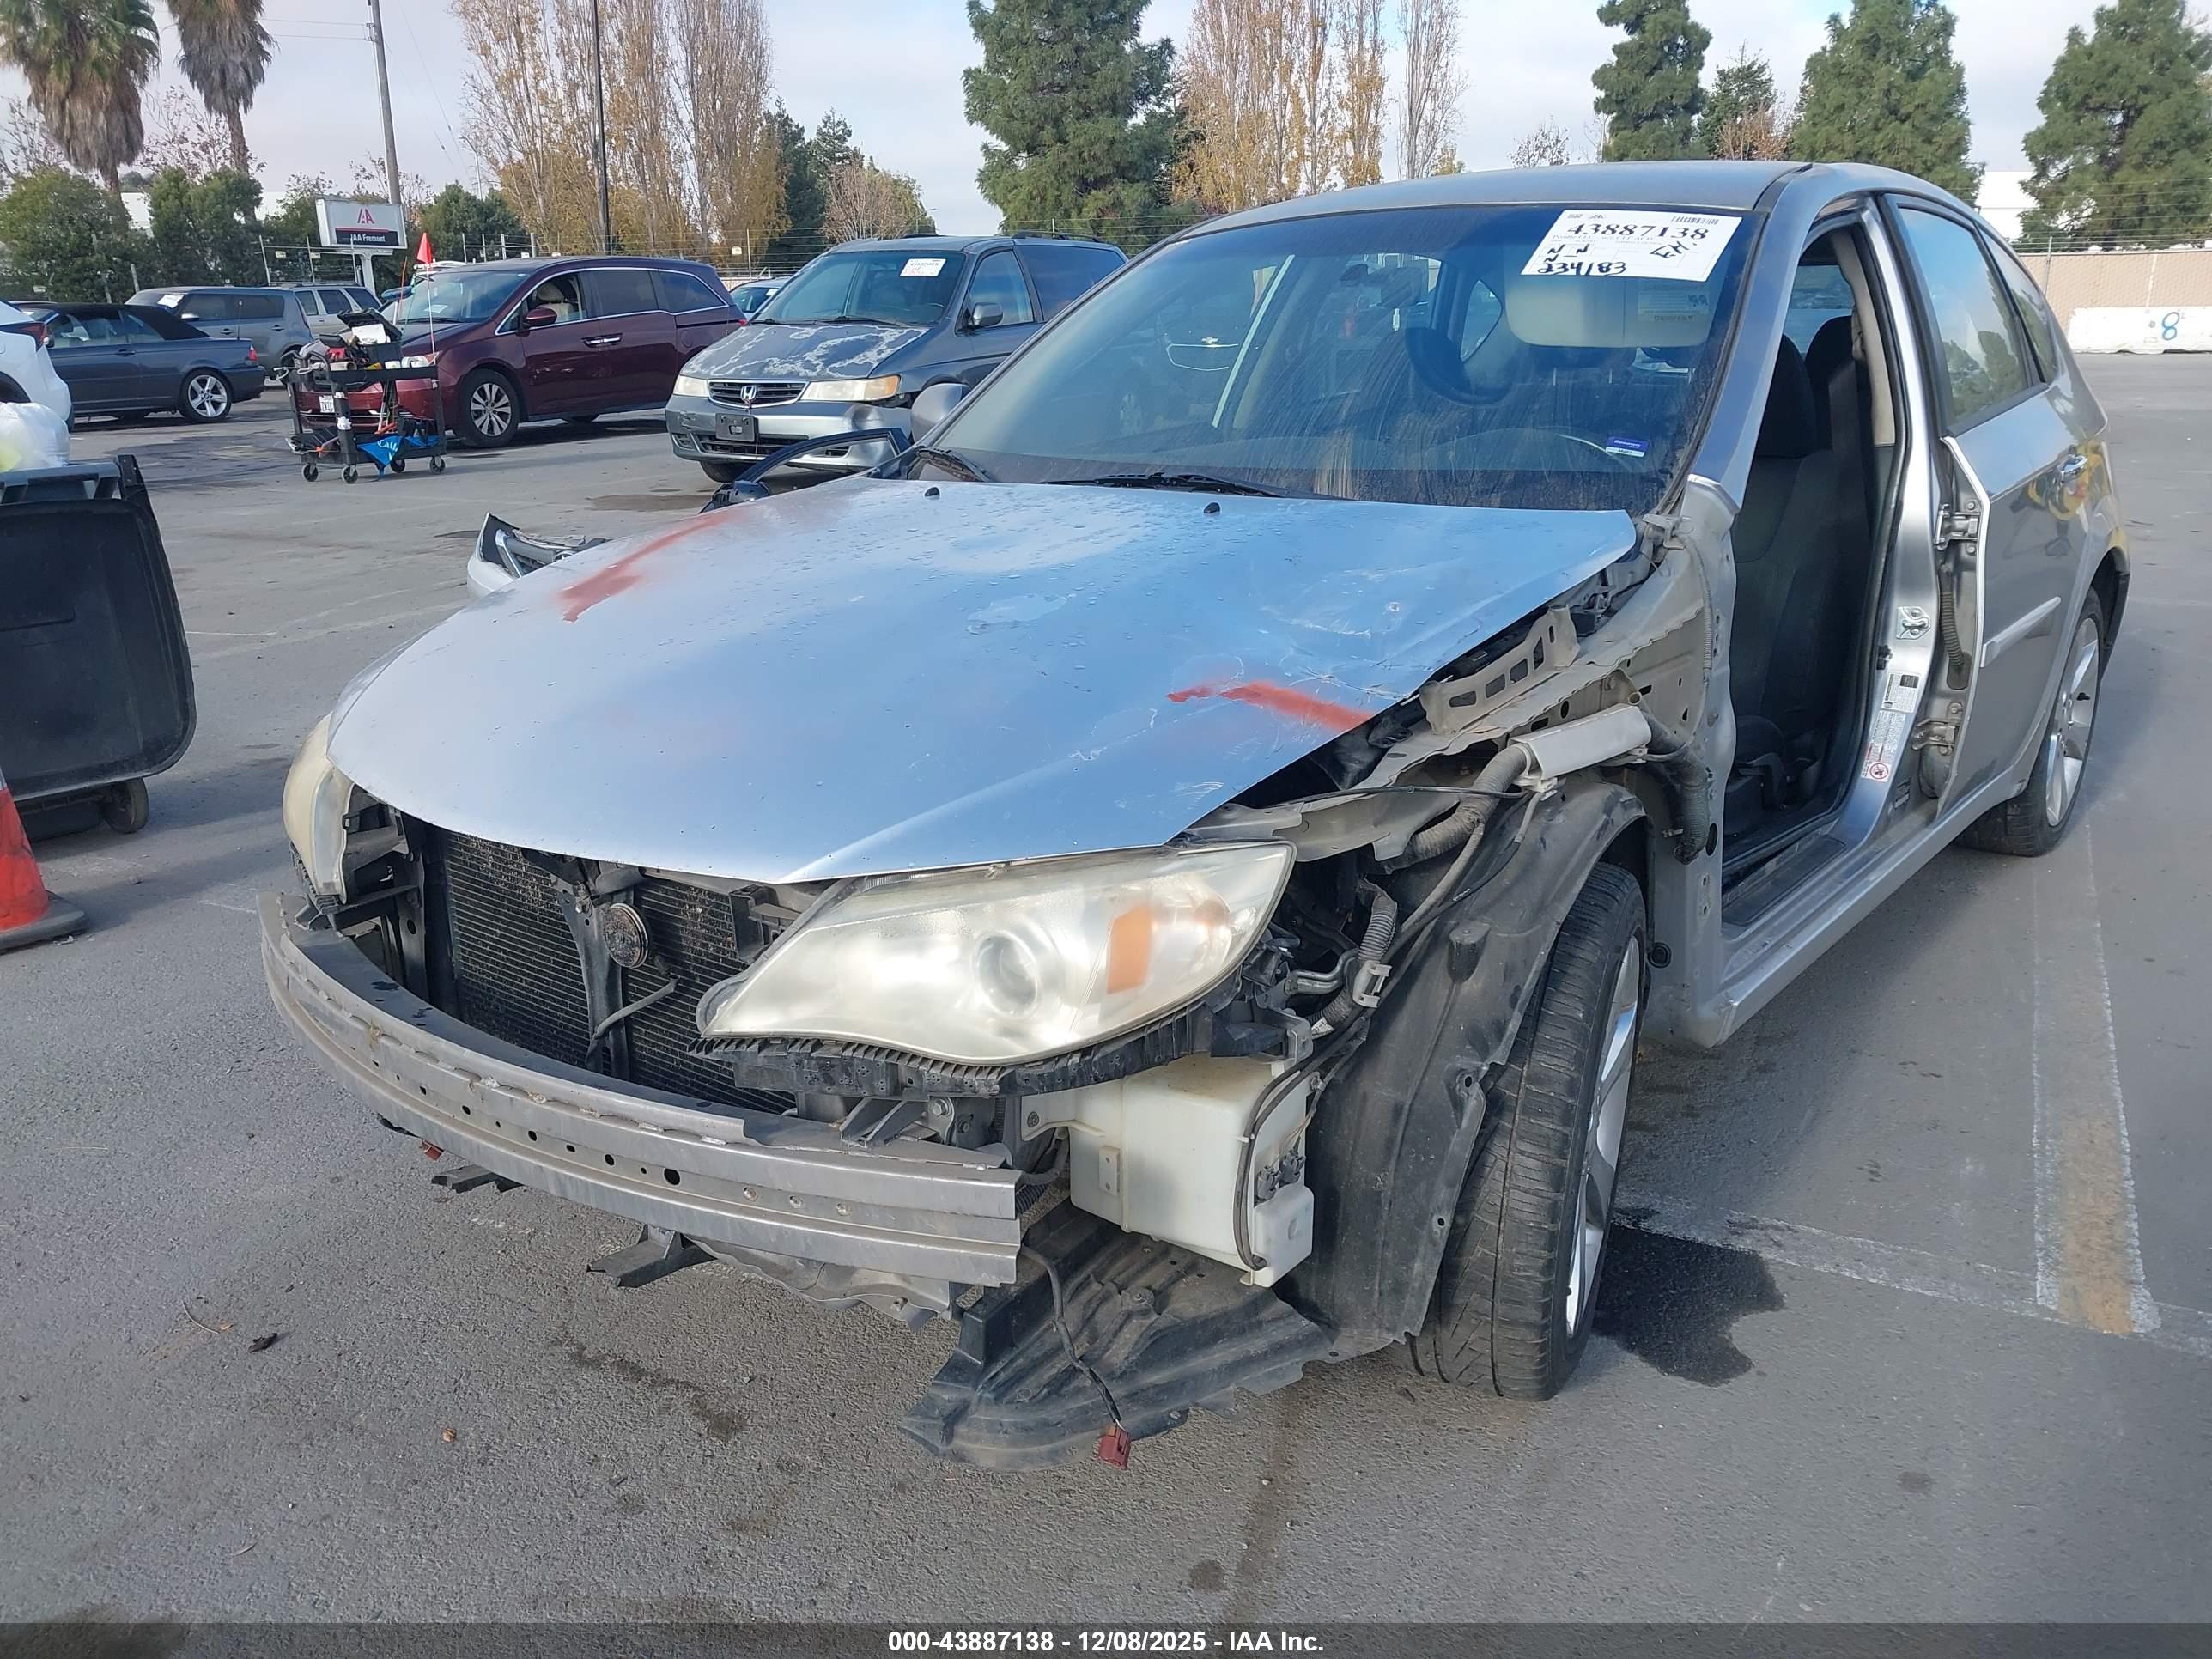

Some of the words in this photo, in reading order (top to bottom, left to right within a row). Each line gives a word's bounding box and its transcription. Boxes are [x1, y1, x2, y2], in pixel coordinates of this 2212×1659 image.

[362, 234, 386, 243] Fremont
[1567, 223, 1709, 240] 43887138
[2161, 311, 2180, 341] 8
